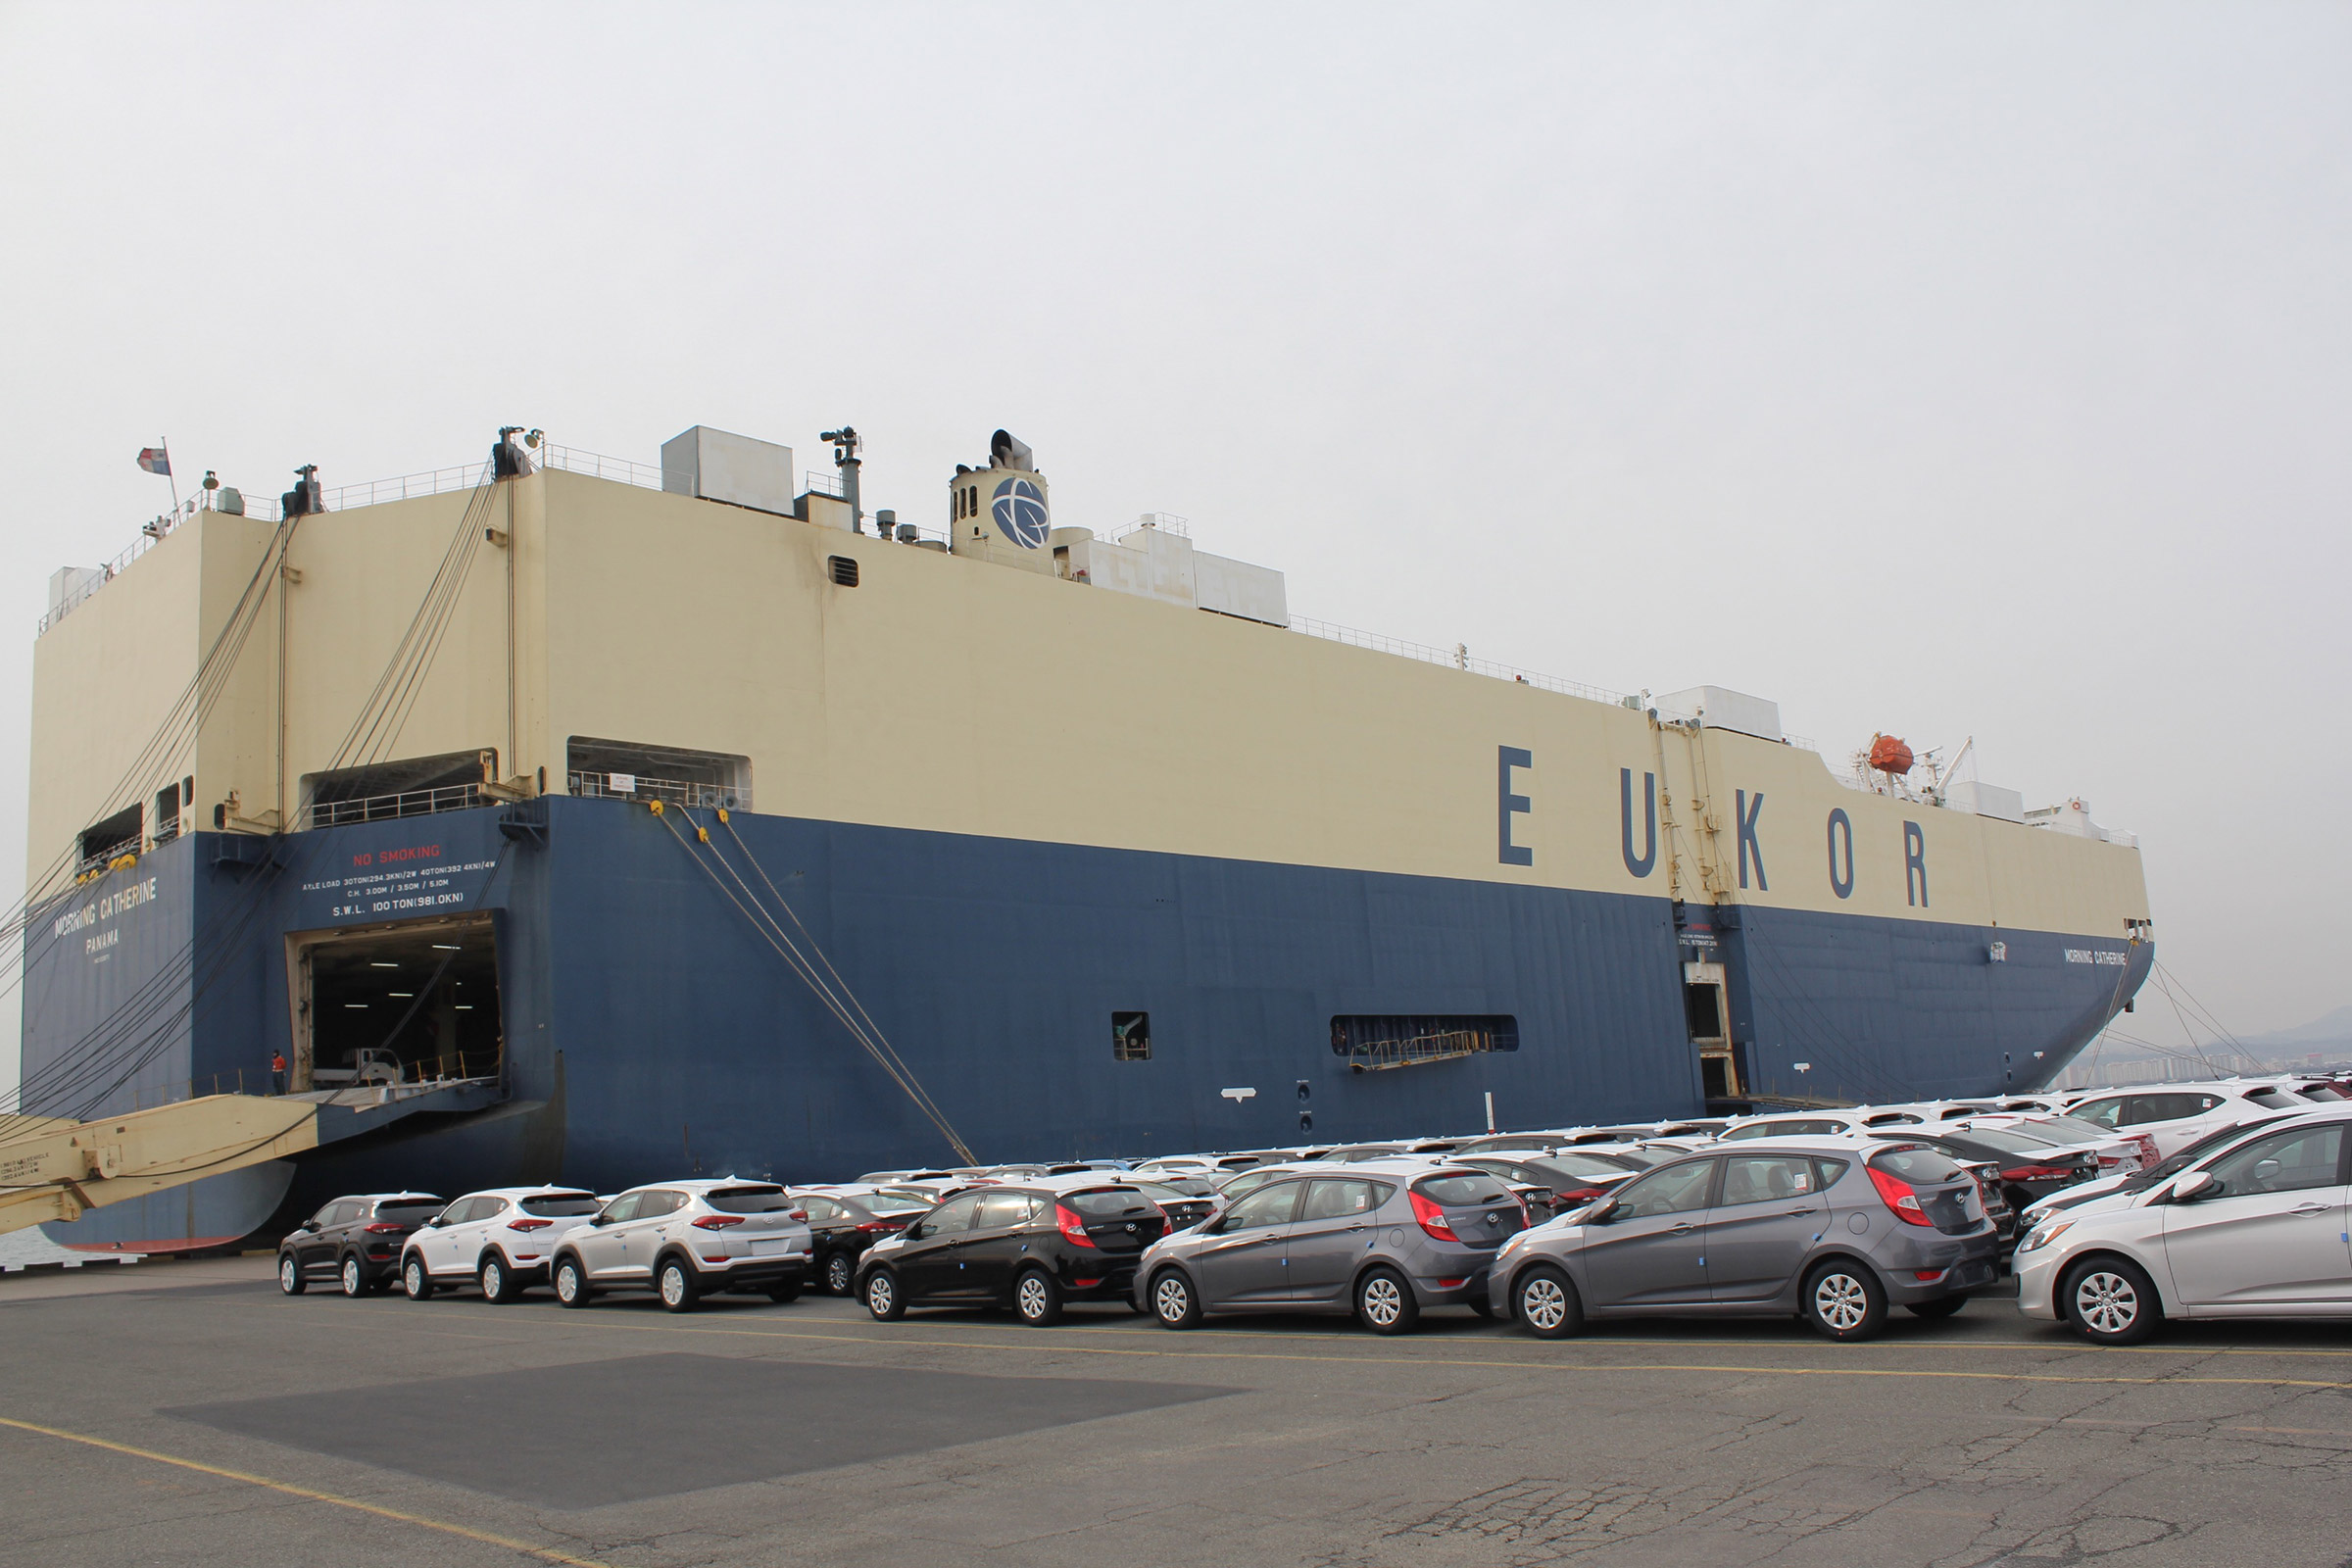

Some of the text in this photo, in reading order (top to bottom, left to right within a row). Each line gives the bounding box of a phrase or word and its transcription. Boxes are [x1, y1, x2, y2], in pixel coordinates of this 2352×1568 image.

[1497, 744, 1929, 907] EUKOR
[354, 845, 440, 867] NO SMOKING
[302, 882, 320, 891] AXLE
[321, 879, 340, 889] LOAD
[366, 886, 387, 896] 3.00M
[397, 882, 419, 892] 3.50M
[55, 877, 157, 939] MORNING CATHERINE
[332, 905, 366, 917] S.W.L.
[372, 902, 390, 912] 100
[86, 929, 119, 955] PANAMA
[2064, 948, 2127, 965] MORNING CATHERINE
